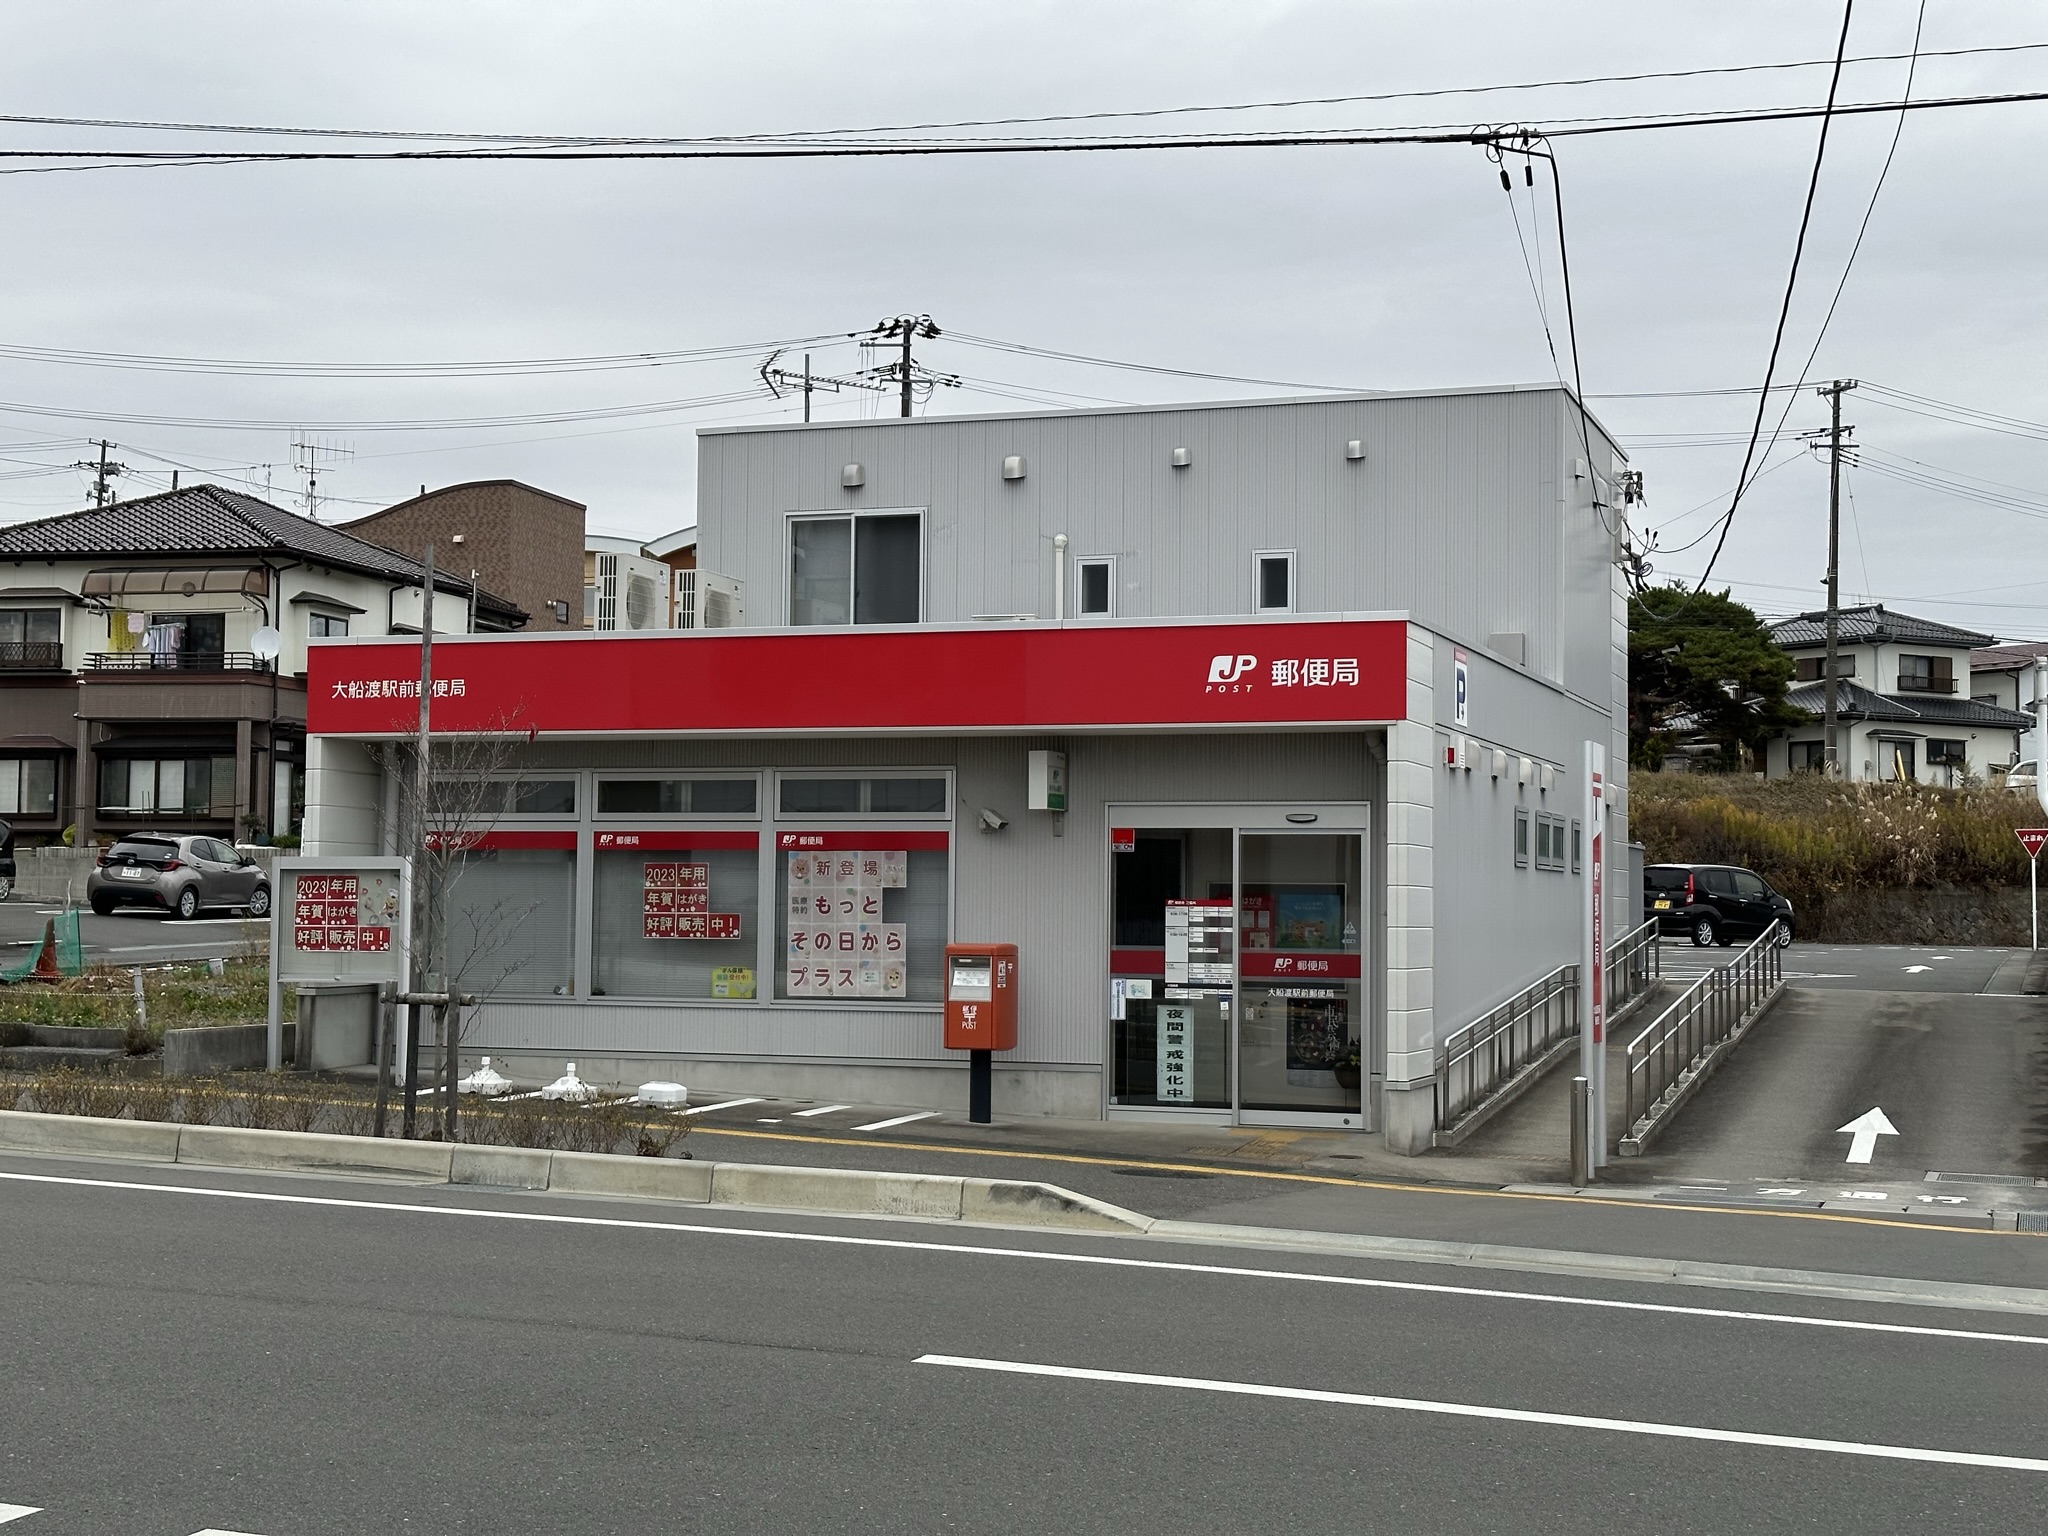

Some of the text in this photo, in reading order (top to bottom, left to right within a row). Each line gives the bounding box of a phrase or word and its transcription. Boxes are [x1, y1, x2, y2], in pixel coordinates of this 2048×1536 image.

[1271, 658, 1359, 687] 郵便局
[332, 679, 466, 699] 大船渡駅前郵便局
[1205, 684, 1253, 694] POST
[1456, 667, 1466, 719] P
[799, 836, 823, 845] 郵便局
[646, 866, 705, 881] 2023年用
[816, 860, 878, 876] 新登場
[298, 879, 356, 893] 2023年用
[647, 891, 707, 906] 年賀はがき
[815, 895, 878, 915] もっと
[298, 904, 357, 918] 年賀はがき
[646, 916, 733, 931] 好評販売中!
[297, 929, 383, 944] 好評販売中!
[790, 932, 902, 951] その日から
[1297, 960, 1329, 971] 郵便局
[790, 966, 854, 987] プラス
[1267, 987, 1335, 998] 大船渡駅前郵便局
[962, 1021, 977, 1029] POST
[1166, 1009, 1184, 1098] 夜間警戒強化中
